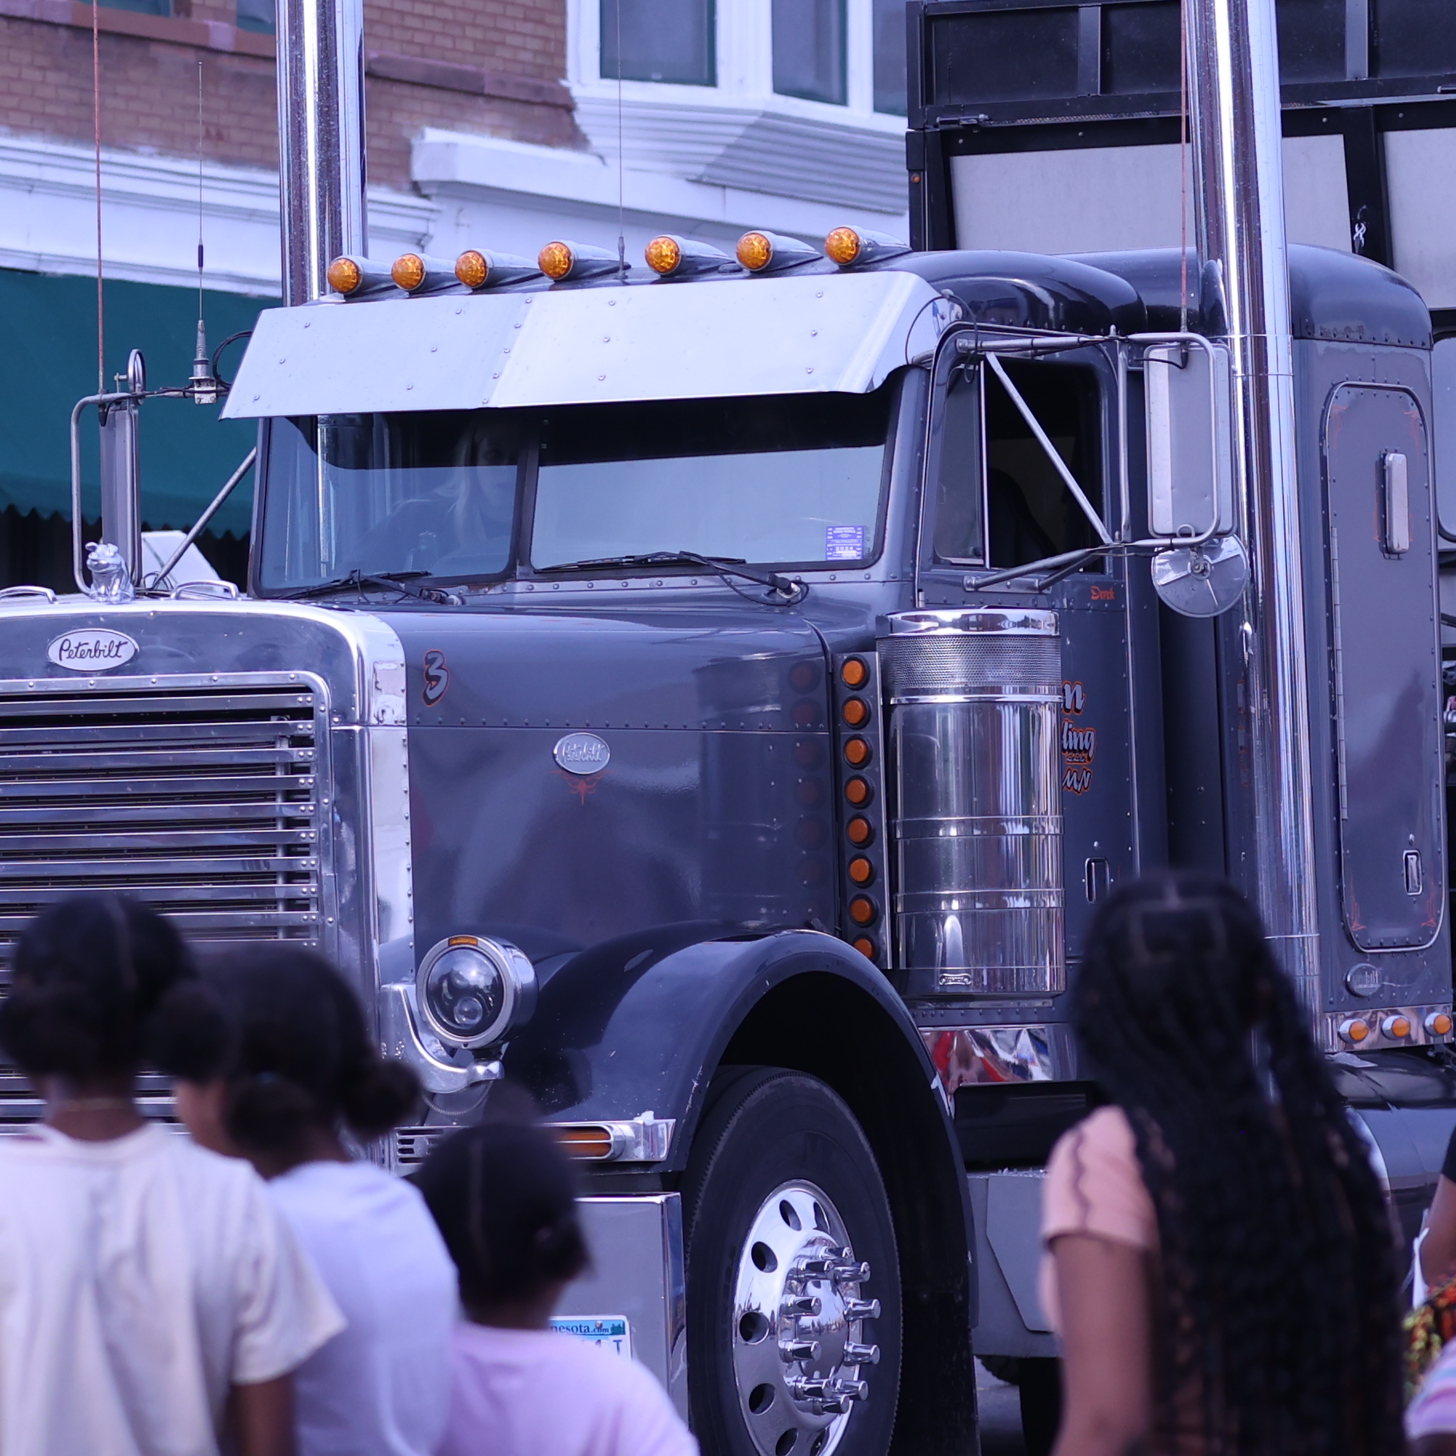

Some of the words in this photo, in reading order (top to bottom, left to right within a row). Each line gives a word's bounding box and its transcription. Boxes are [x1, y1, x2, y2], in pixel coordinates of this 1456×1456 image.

[59, 638, 128, 662] Peterbilt
[422, 649, 450, 707] 3
[550, 1322, 609, 1335] nesota.com
